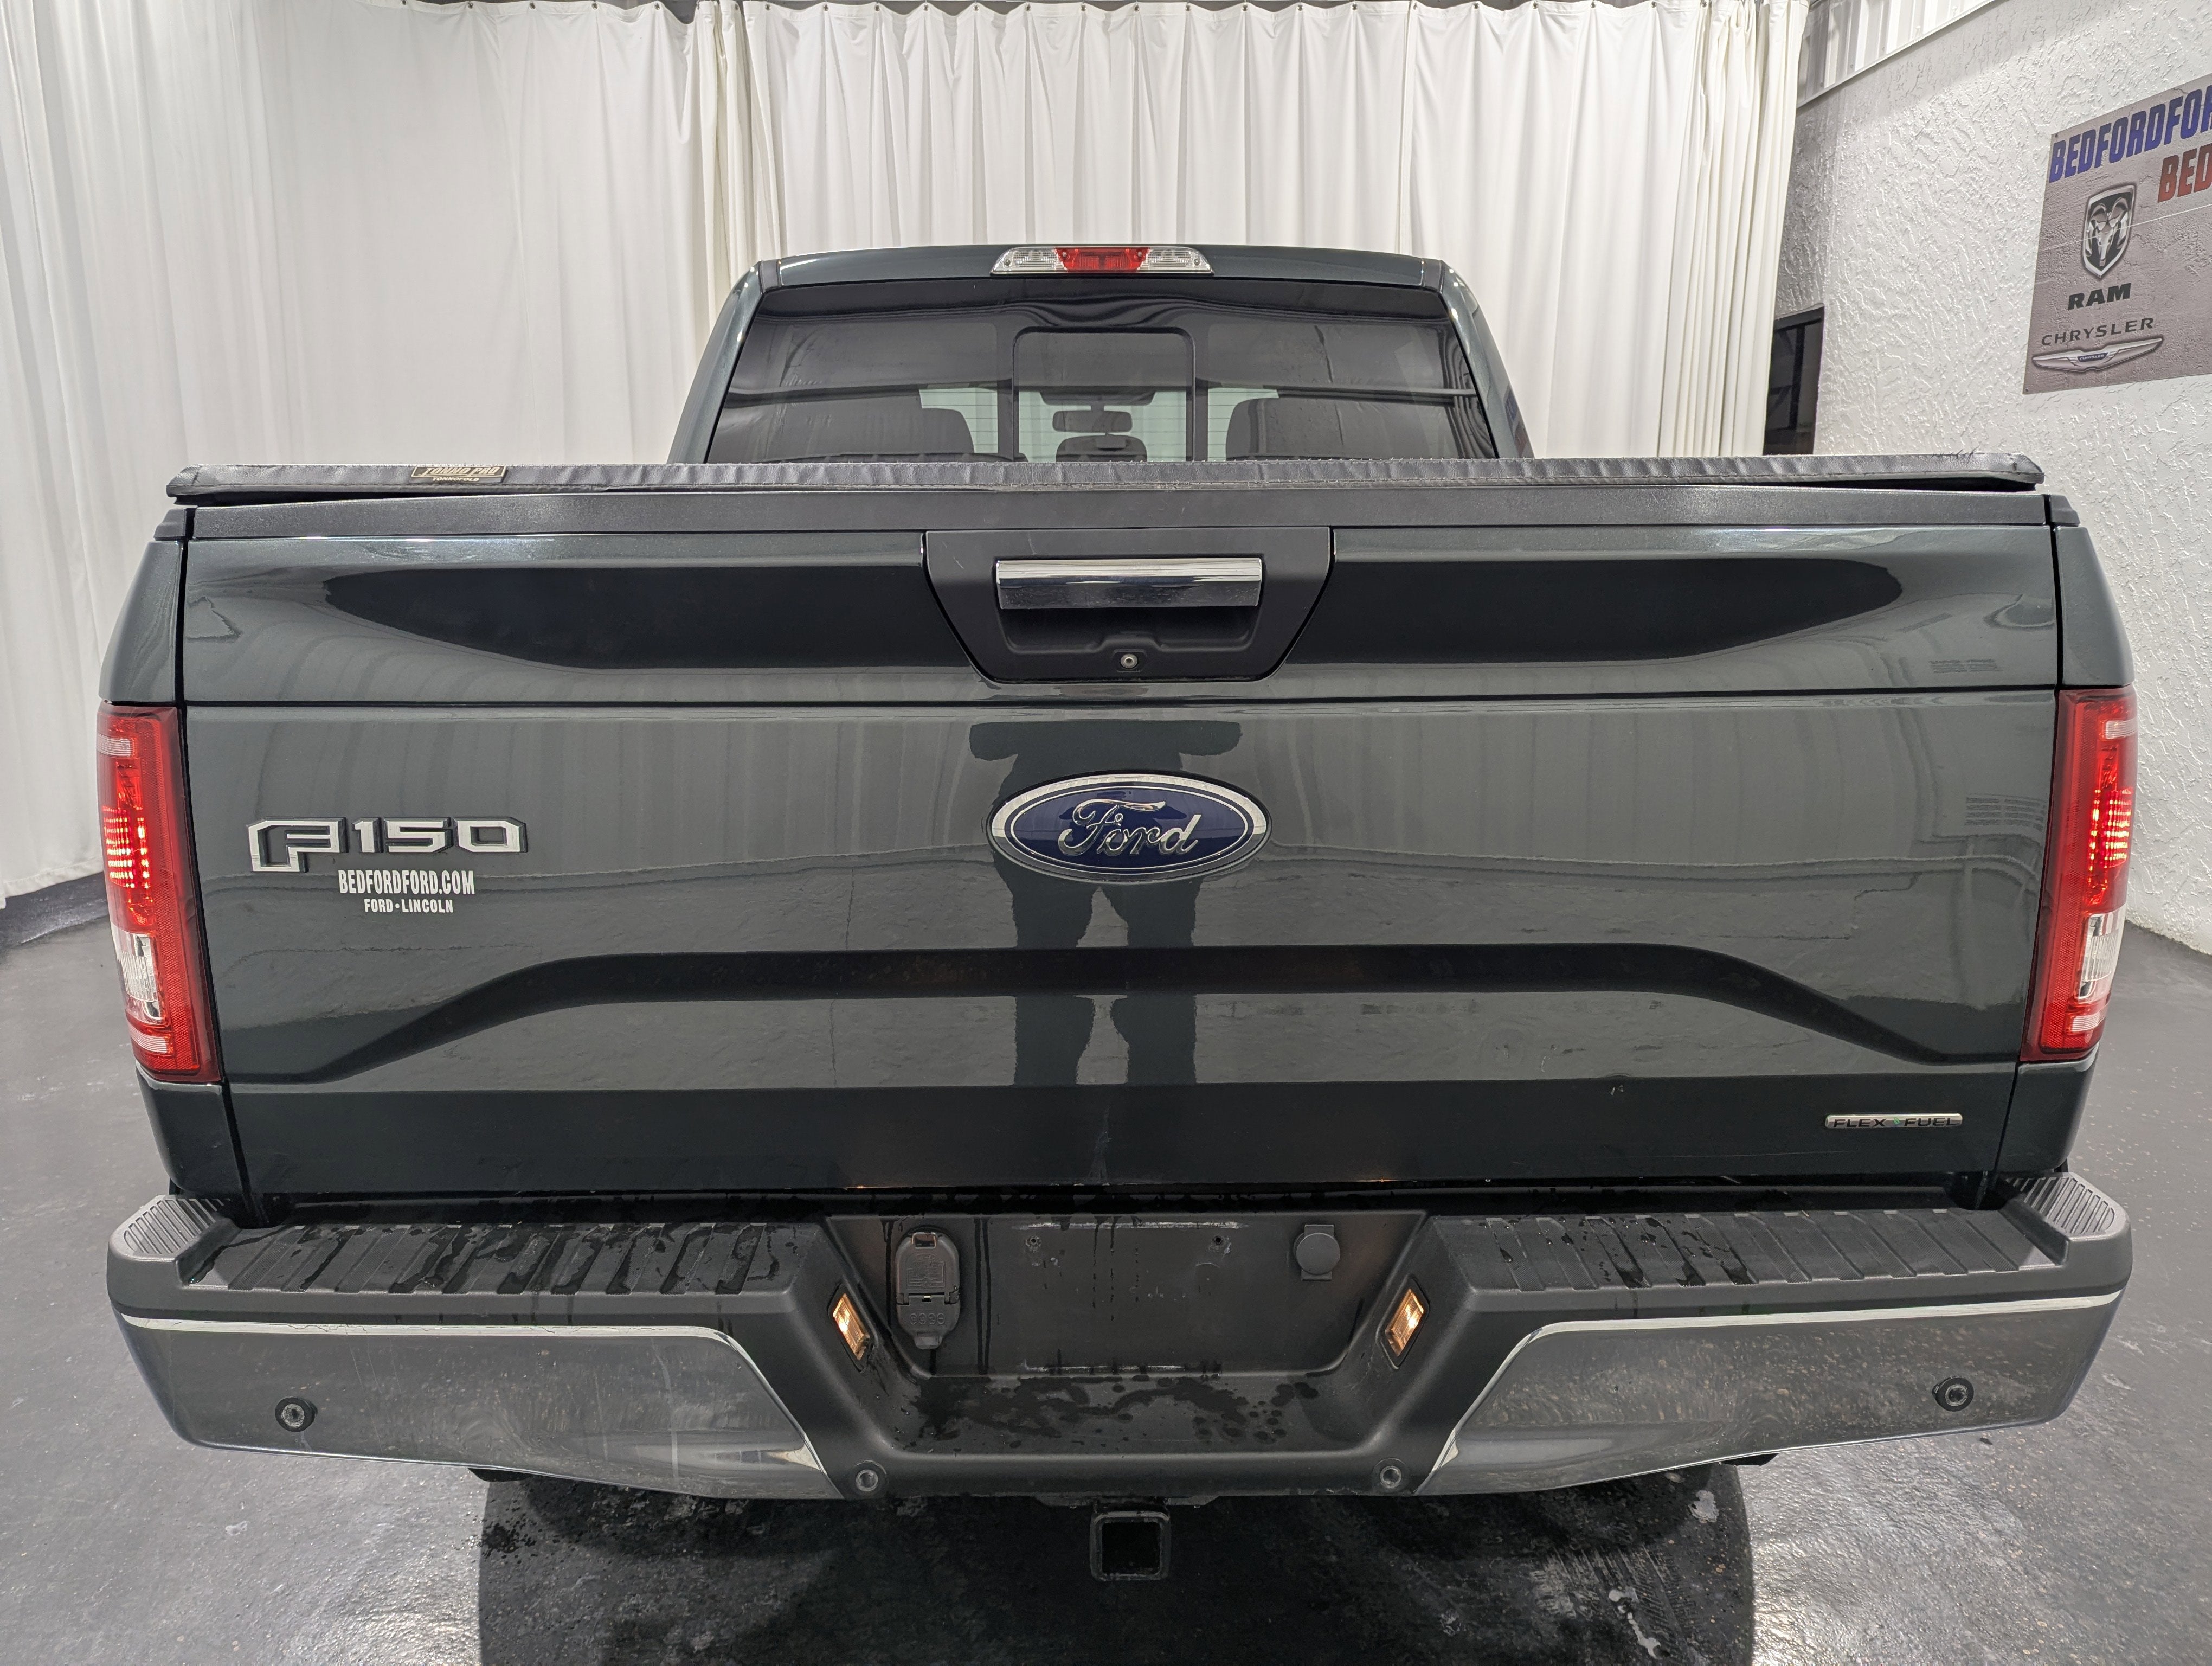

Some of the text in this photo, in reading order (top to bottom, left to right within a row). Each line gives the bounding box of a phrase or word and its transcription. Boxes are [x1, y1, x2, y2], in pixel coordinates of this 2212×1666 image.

[2068, 283, 2131, 310] RAM
[2041, 317, 2154, 346] CHRYSLER
[419, 466, 500, 477] TONNO PRO
[1058, 798, 1202, 856] Ford
[338, 870, 475, 895] BEDFORDFORD.COM
[1833, 1117, 1957, 1127] FLEX FUEL
